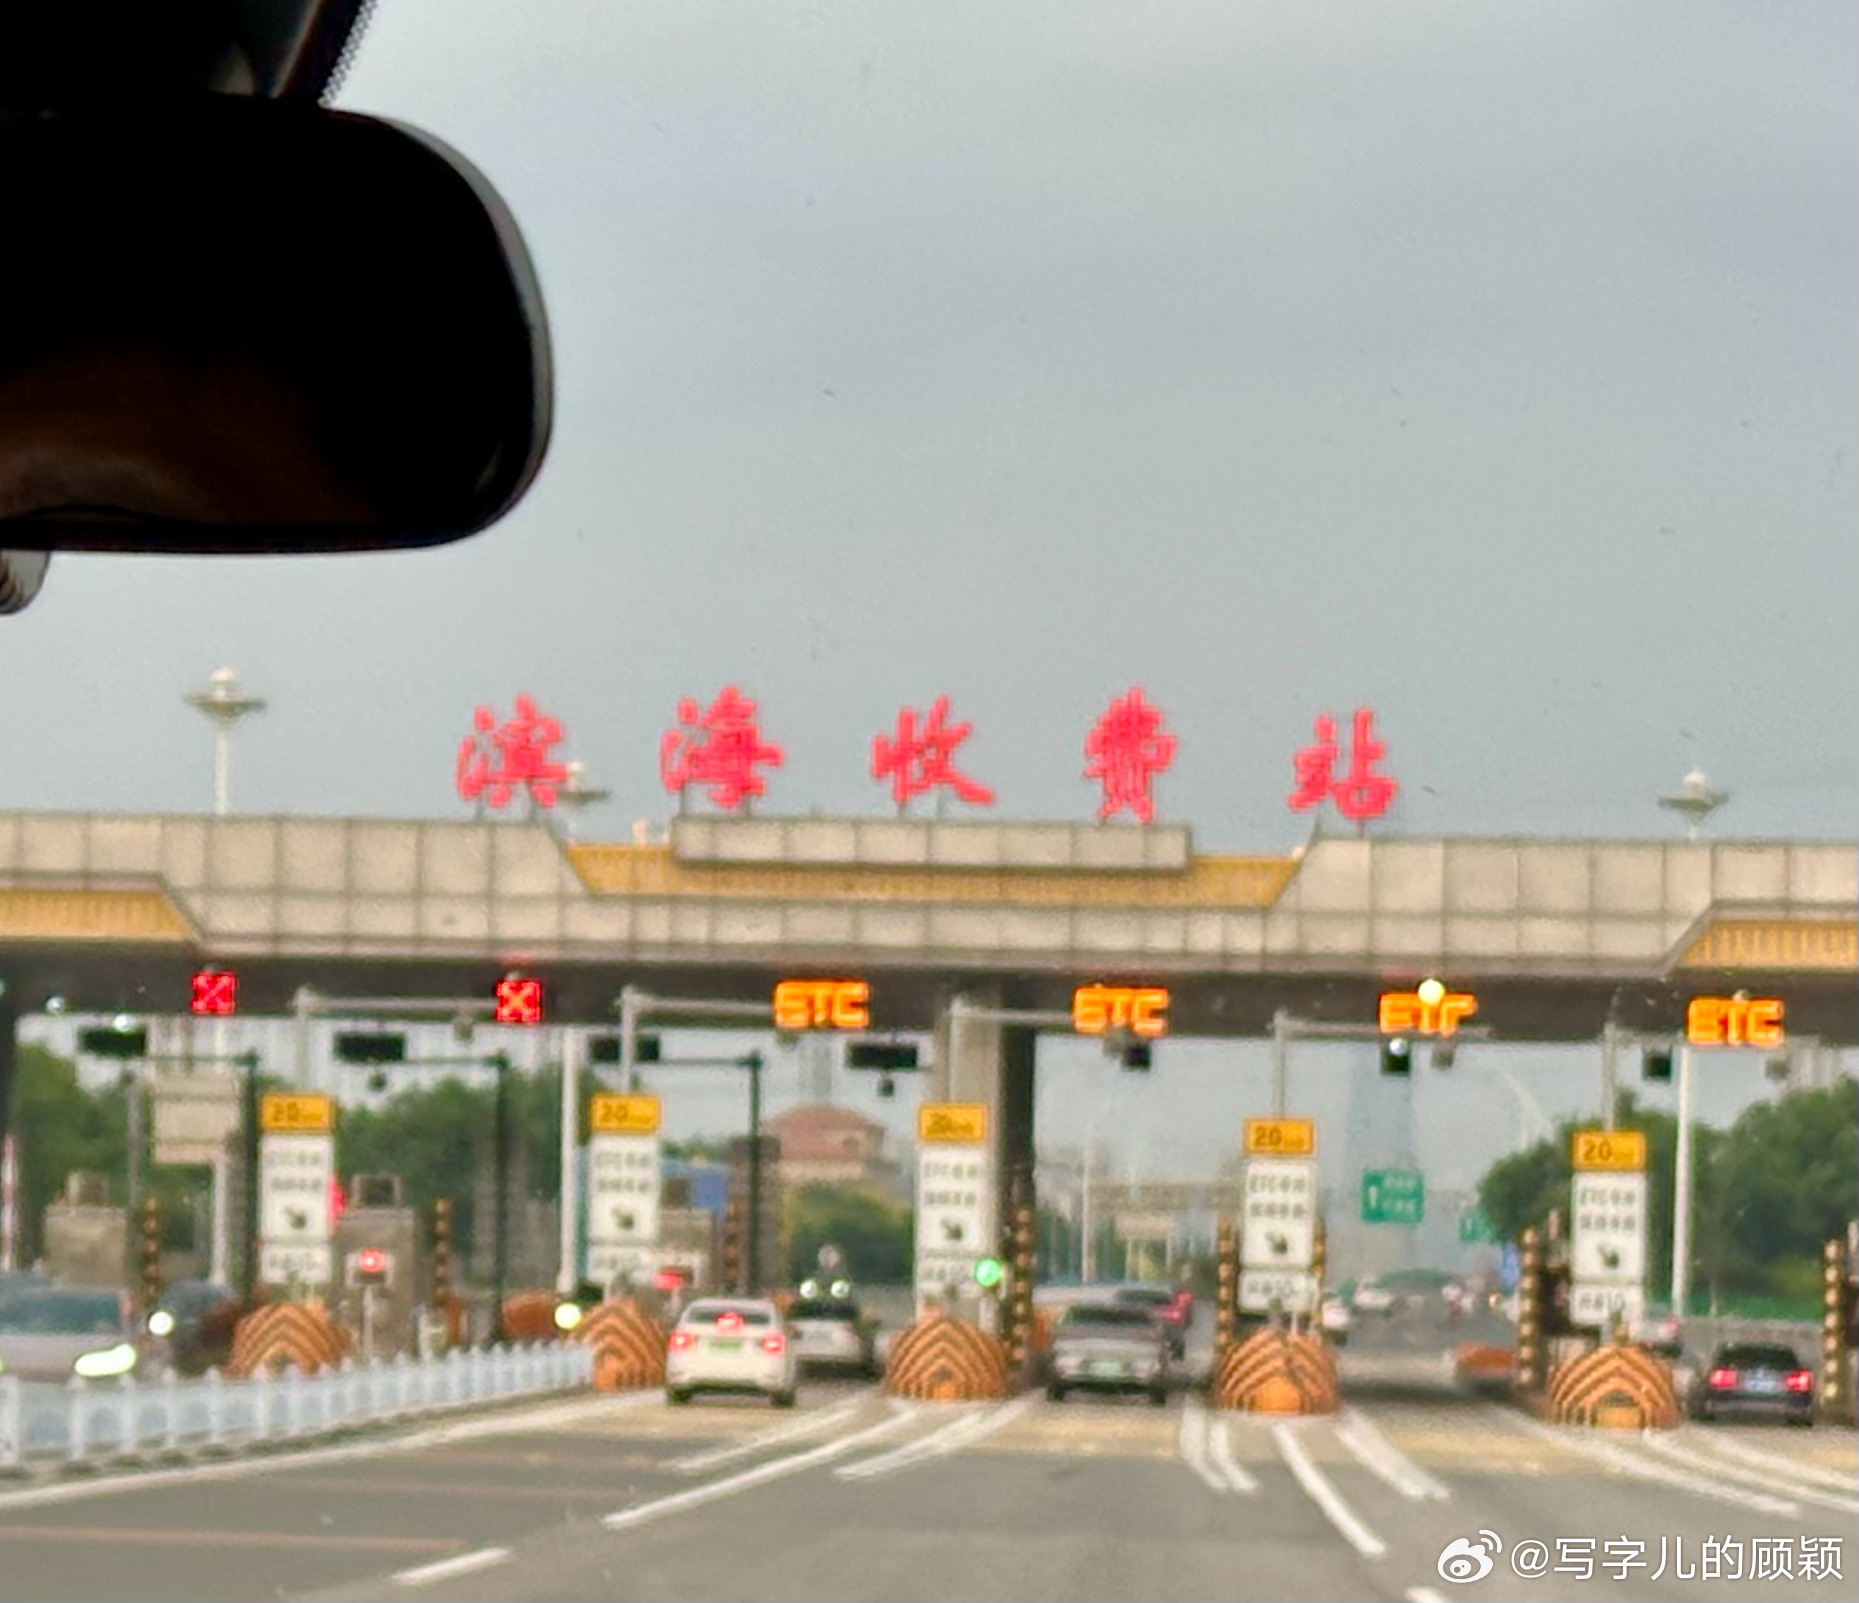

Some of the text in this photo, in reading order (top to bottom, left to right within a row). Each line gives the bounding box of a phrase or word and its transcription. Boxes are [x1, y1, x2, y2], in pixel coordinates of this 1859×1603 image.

[456, 687, 1399, 823] 滨海收费站
[774, 981, 869, 1029] ETC
[1074, 985, 1169, 1036] ETC
[1688, 997, 1783, 1046] ETC
